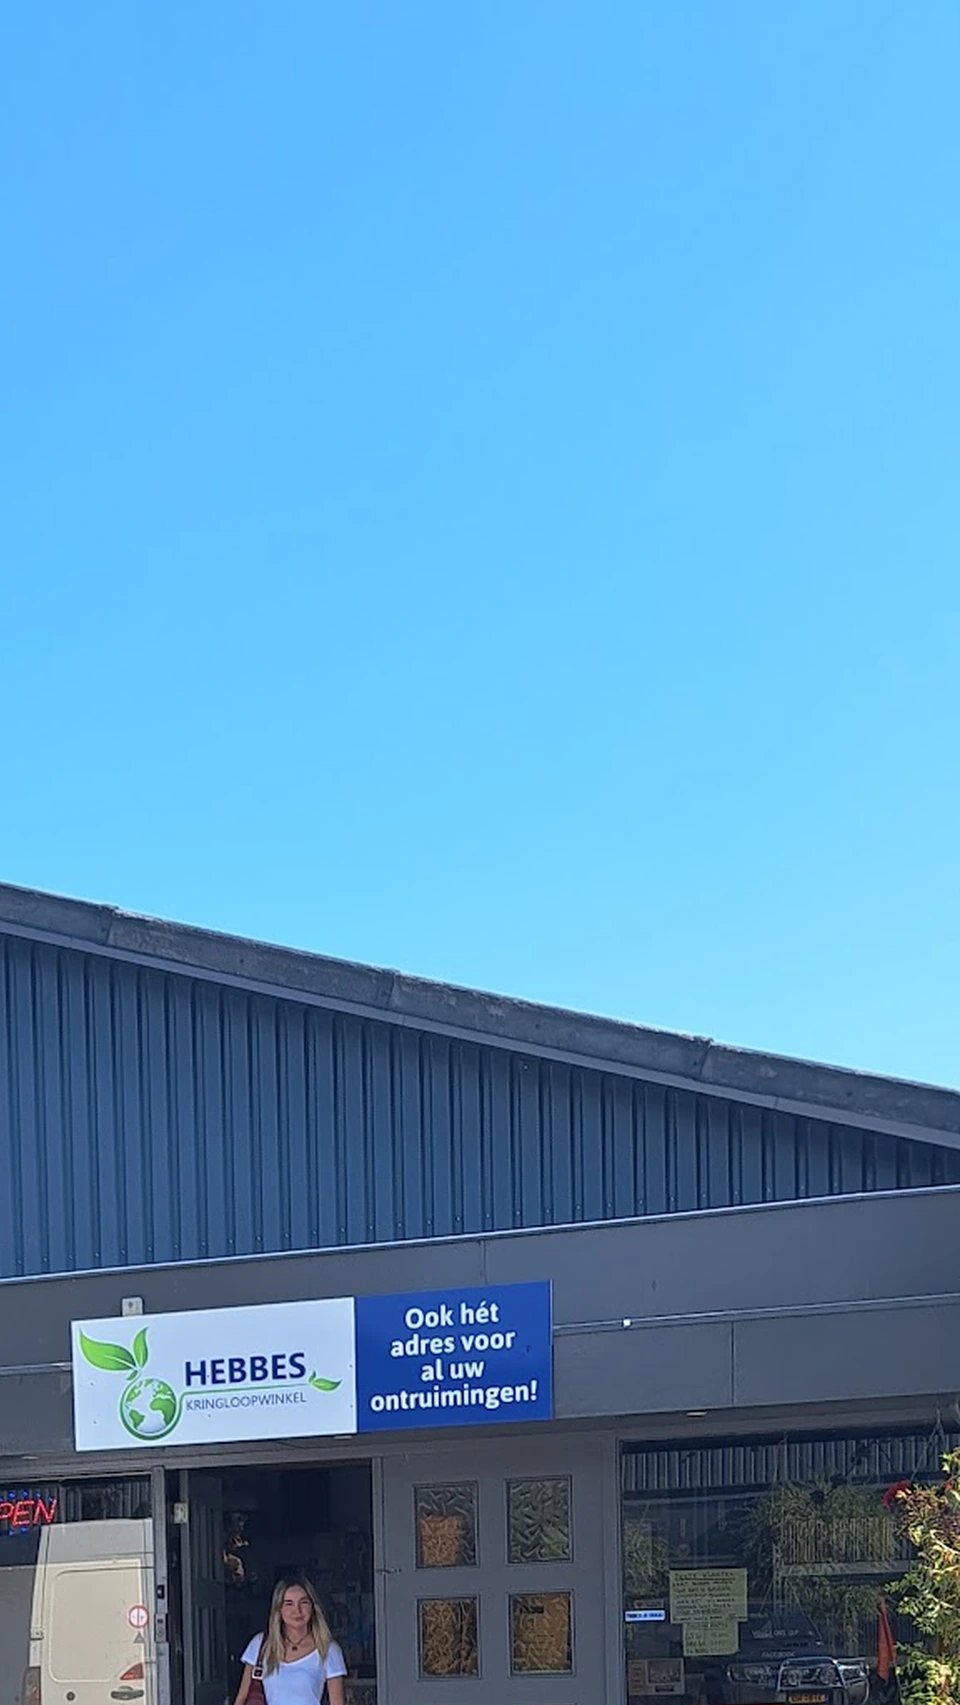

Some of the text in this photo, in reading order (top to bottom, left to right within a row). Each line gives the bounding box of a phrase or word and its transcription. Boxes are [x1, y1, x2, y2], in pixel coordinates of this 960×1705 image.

[404, 1300, 500, 1330] Ook hét
[390, 1331, 517, 1357] adres voor
[184, 1351, 306, 1387] HEBBES
[421, 1359, 485, 1381] al uw
[185, 1391, 307, 1412] KRINGLOOPWINKEL
[370, 1379, 538, 1413] ontruimingen!
